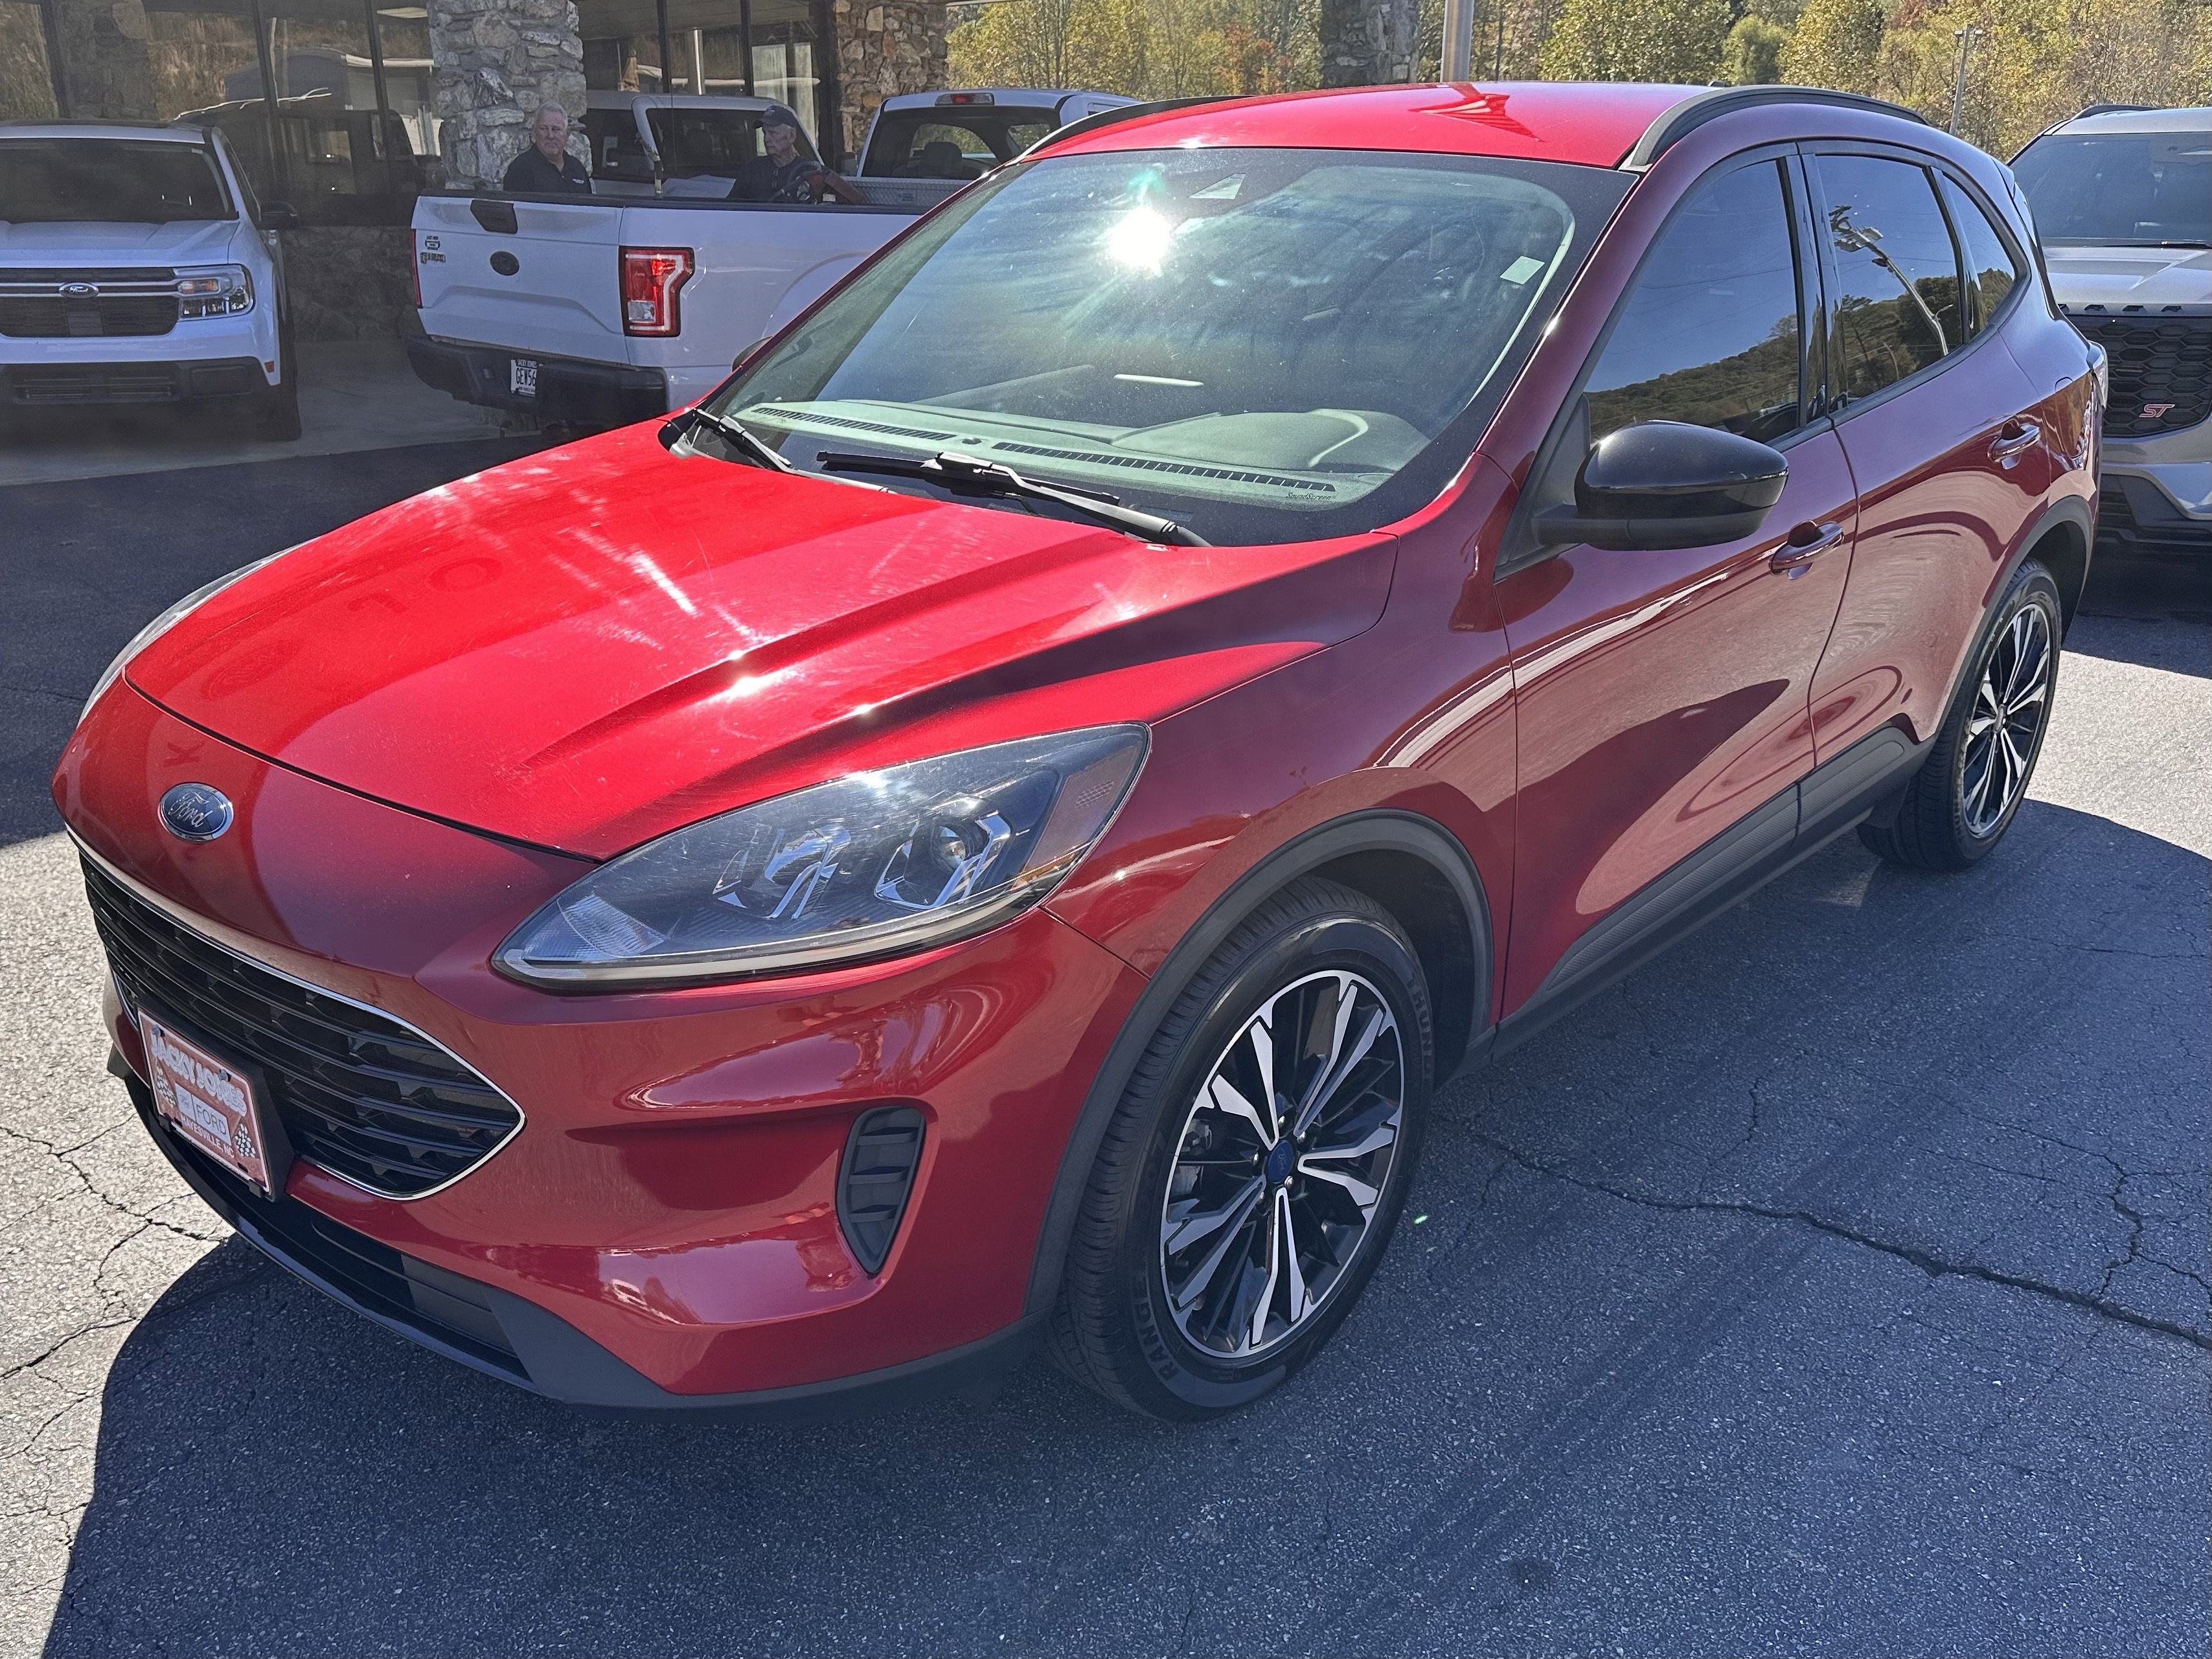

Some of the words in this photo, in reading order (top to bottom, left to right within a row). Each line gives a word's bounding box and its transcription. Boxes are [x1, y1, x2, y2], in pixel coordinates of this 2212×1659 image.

[2139, 404, 2176, 418] ST
[1286, 492, 1332, 501] SoundScreen
[168, 791, 213, 827] Ford
[150, 1029, 196, 1084] JACKY
[196, 1062, 247, 1117] JONES
[181, 1114, 223, 1152] HAYESVILLE,
[223, 1143, 234, 1158] NC
[196, 1103, 227, 1136] FORD
